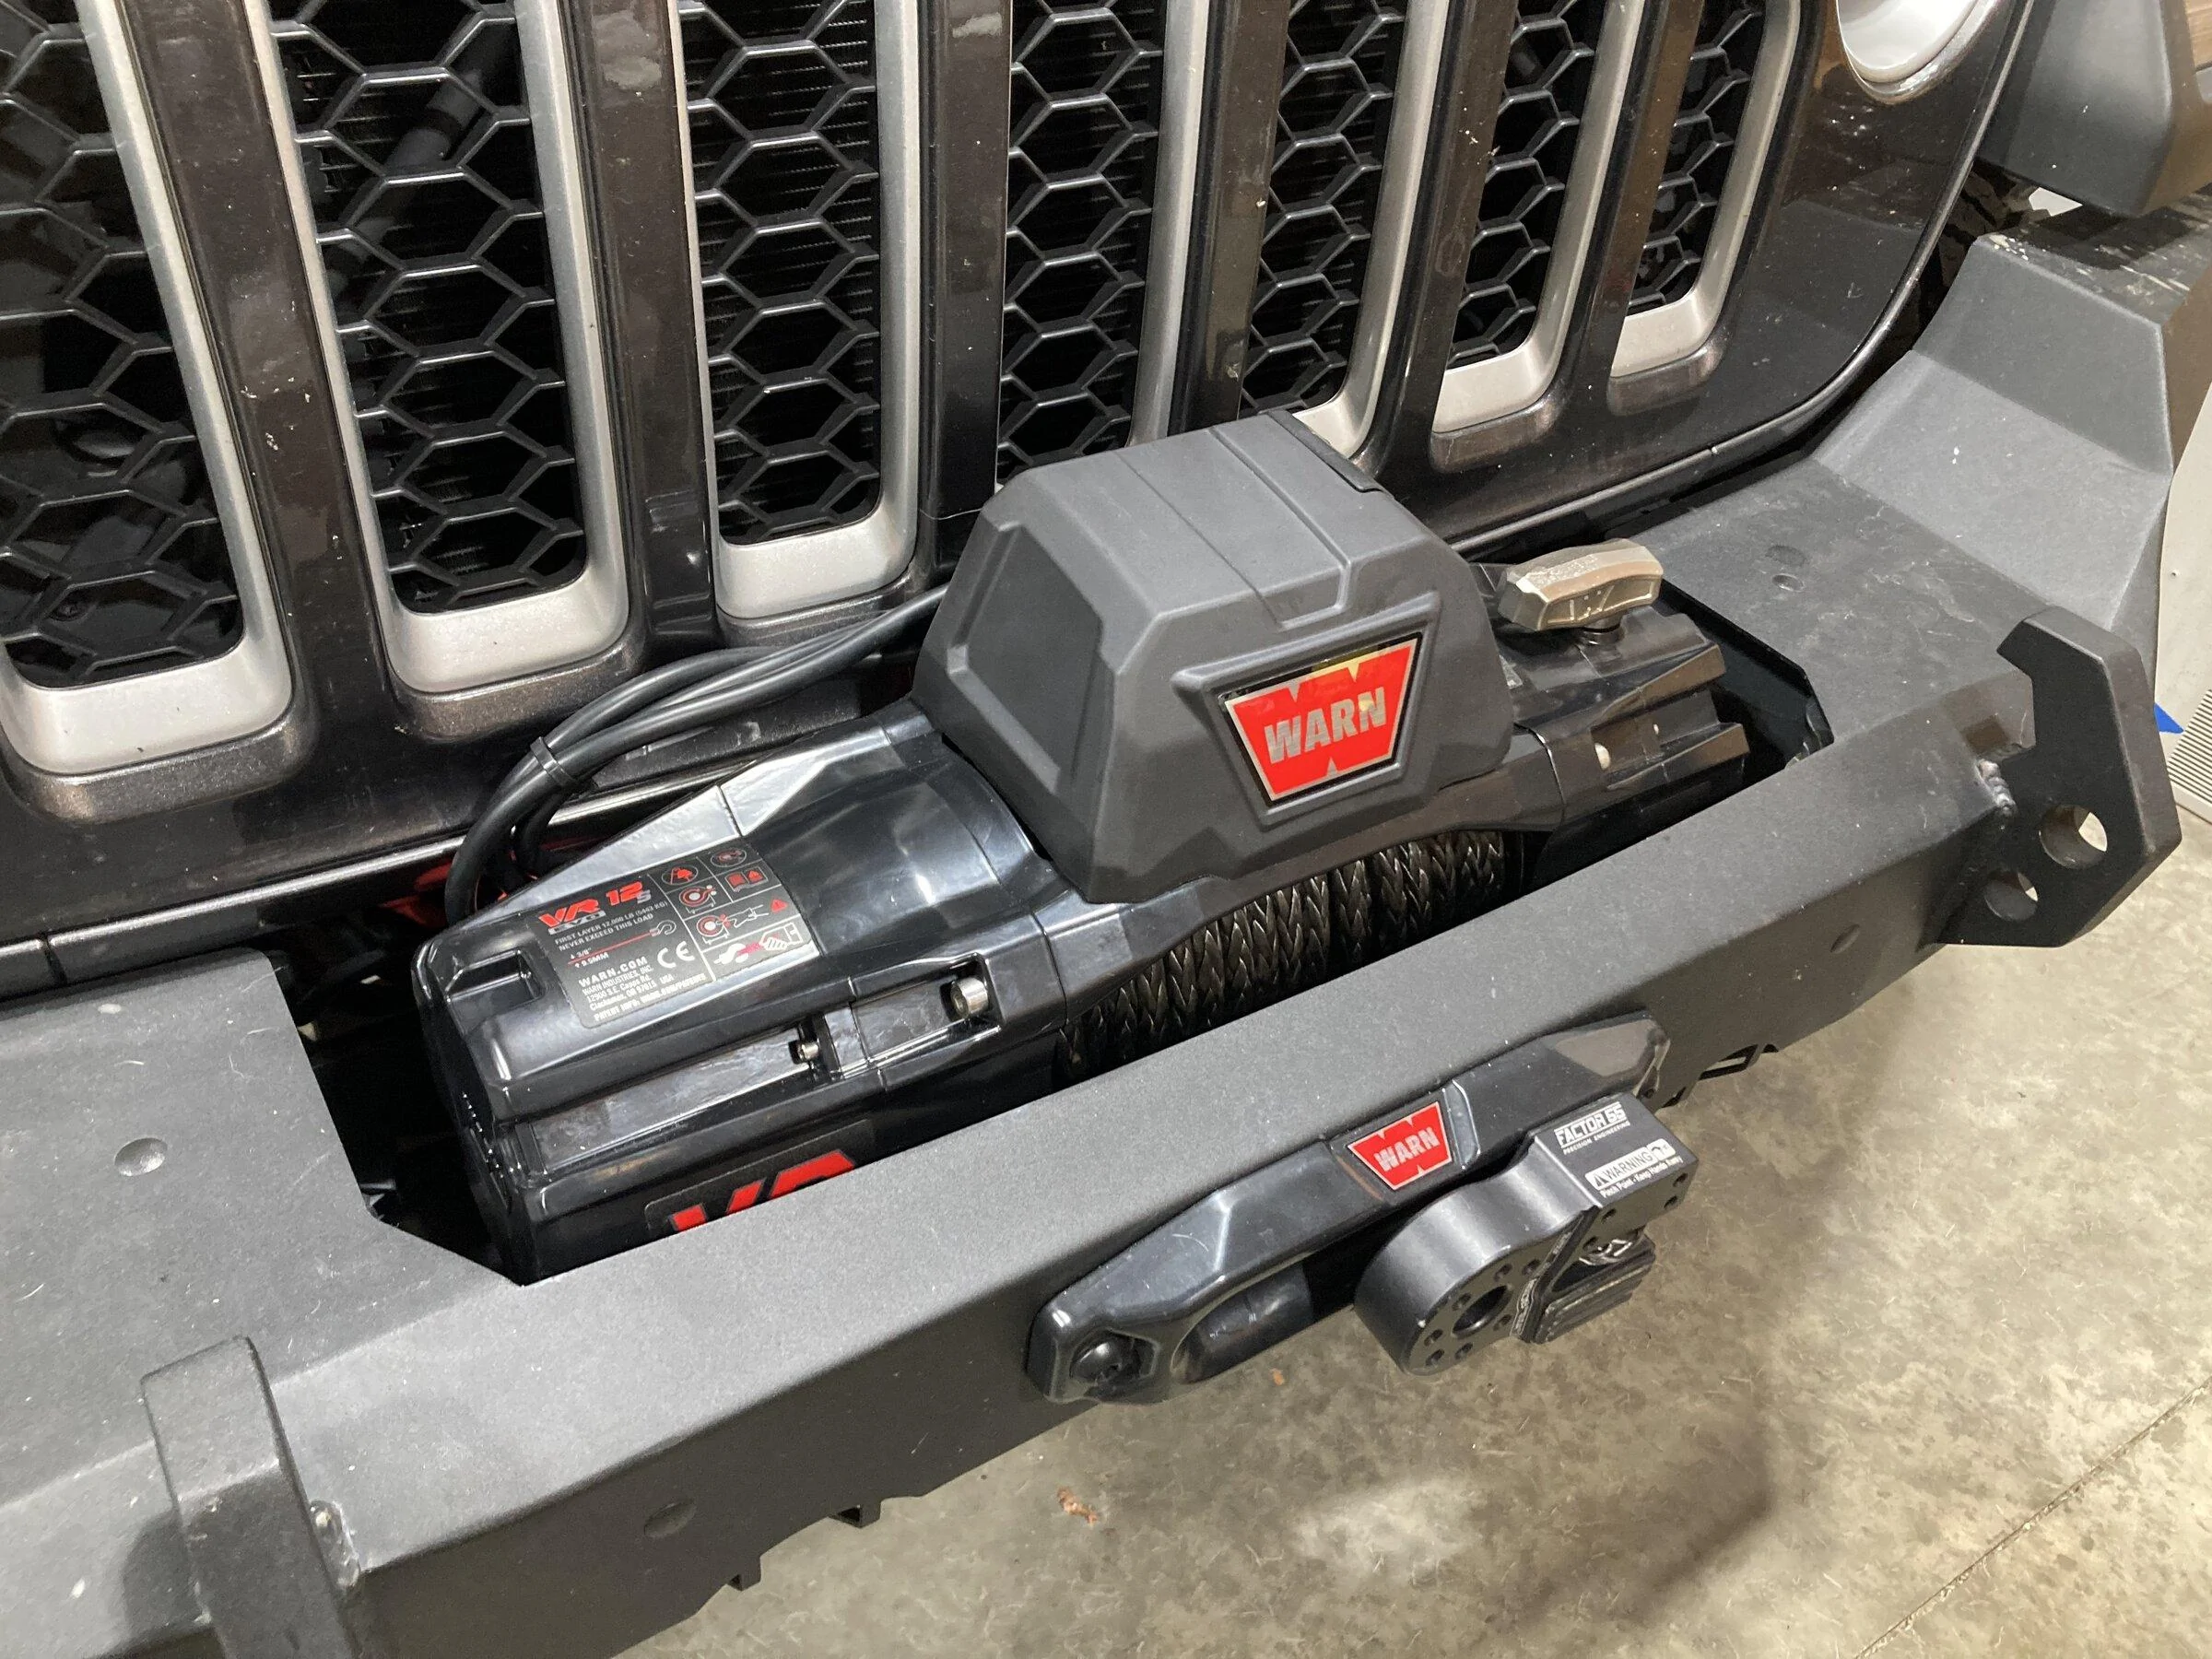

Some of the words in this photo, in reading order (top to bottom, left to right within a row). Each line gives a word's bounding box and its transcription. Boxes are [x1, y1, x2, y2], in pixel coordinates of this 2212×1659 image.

[1264, 686, 1387, 765] WARN
[538, 899, 599, 928] VR
[555, 933, 575, 944] FIRST
[577, 924, 601, 936] LAYER
[559, 937, 583, 950] NEVER
[585, 927, 613, 941] EXCEED
[615, 921, 632, 930] THIS
[633, 912, 653, 924] LOAD
[578, 957, 648, 987] WARN.COM
[582, 983, 602, 995] WARN
[586, 990, 607, 1002] 12900
[1555, 1112, 1606, 1146] FACTOR
[1604, 1102, 1626, 1124] 55
[1562, 1137, 1592, 1155] PRECISION
[1593, 1120, 1630, 1141] ENGINEERING
[1373, 1126, 1441, 1171] WARN
[1603, 1149, 1653, 1181] WARNING
